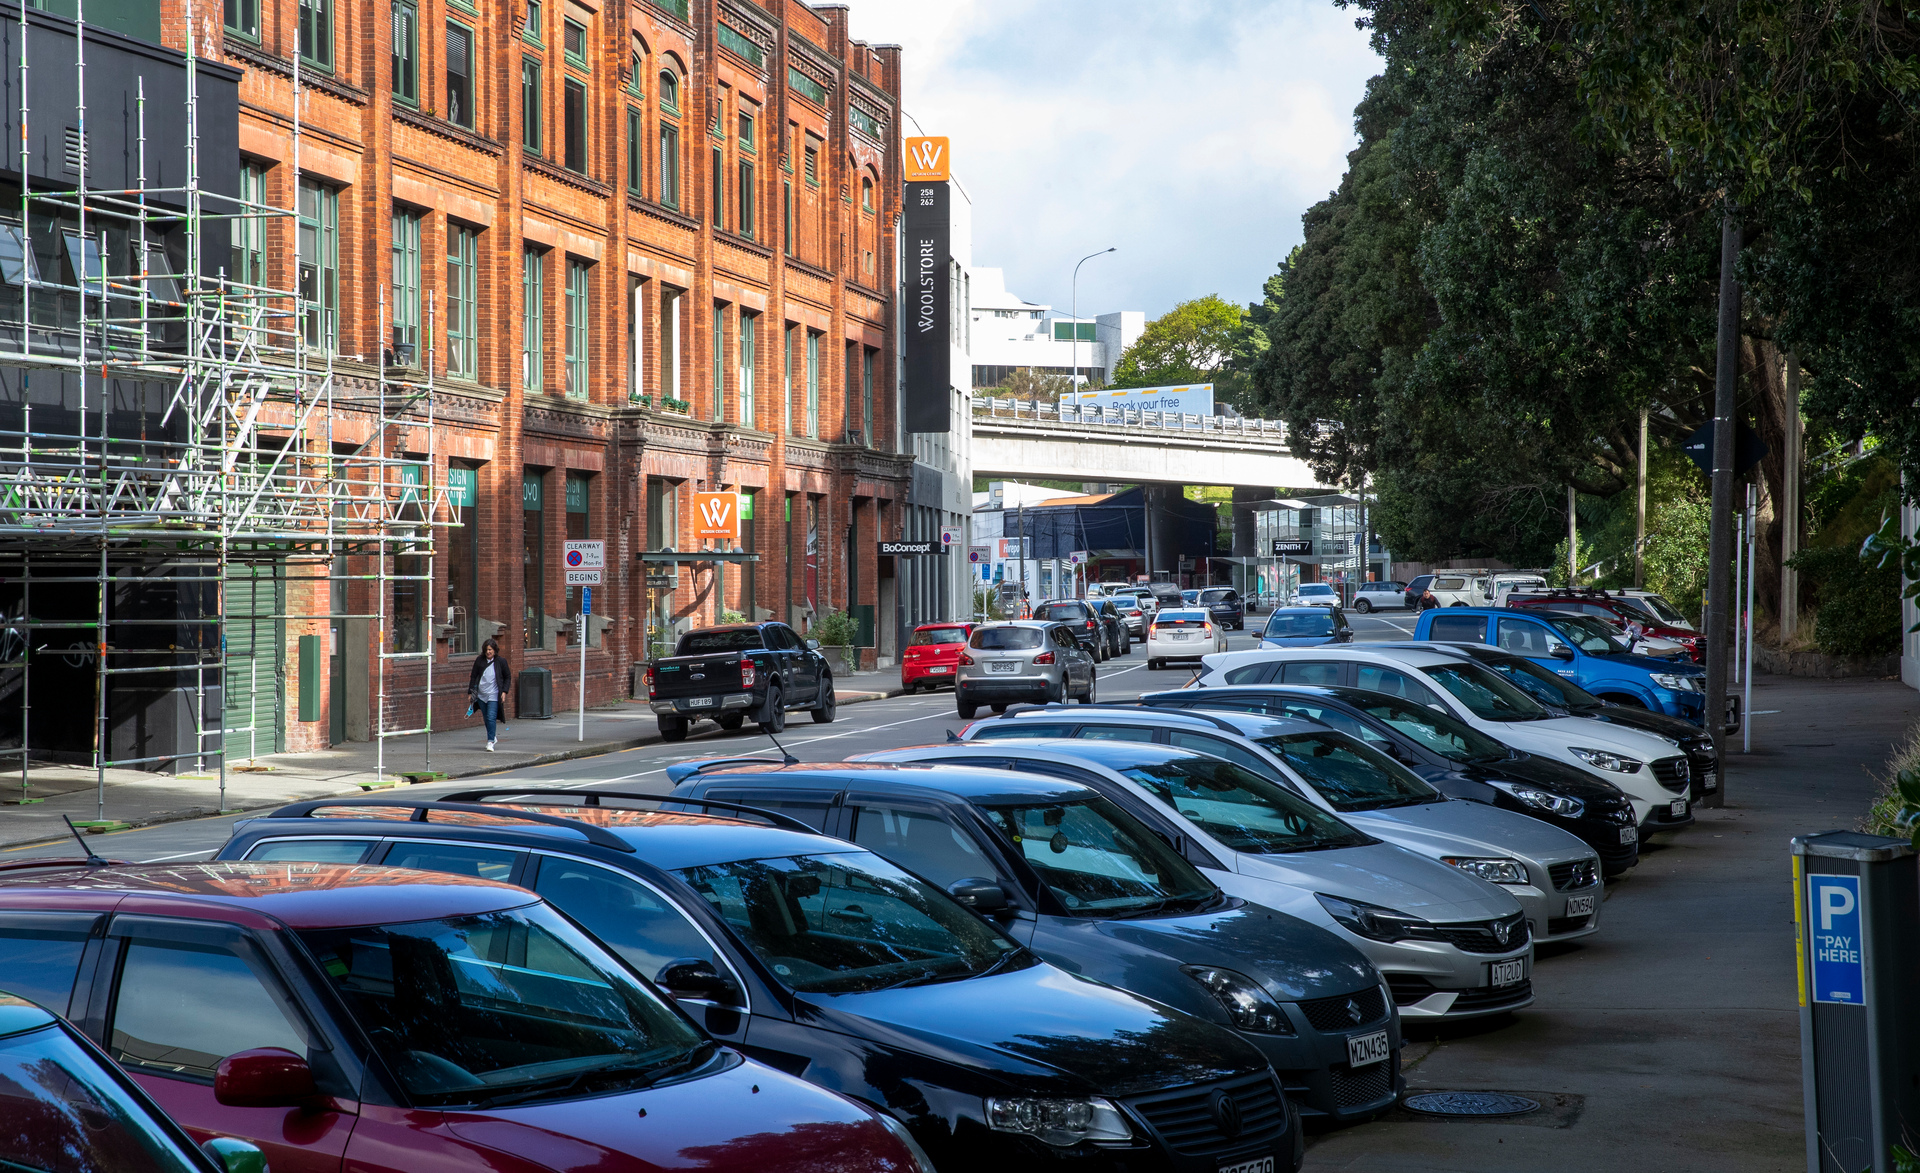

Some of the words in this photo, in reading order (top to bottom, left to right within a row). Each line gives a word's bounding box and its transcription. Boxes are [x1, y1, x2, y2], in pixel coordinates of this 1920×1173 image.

[918, 239, 934, 333] WOOLSTORE
[1112, 400, 1136, 411] Book
[1137, 399, 1159, 412] your
[1160, 397, 1180, 408] free
[882, 543, 931, 554] BoConcept
[1275, 543, 1301, 551] ZENITH
[568, 573, 599, 582] BEGINS
[1568, 896, 1593, 915] NDN594
[1819, 885, 1855, 930] P
[1825, 935, 1852, 949] PAY
[1819, 948, 1859, 964] HERE
[1350, 1035, 1388, 1063] MZN435
